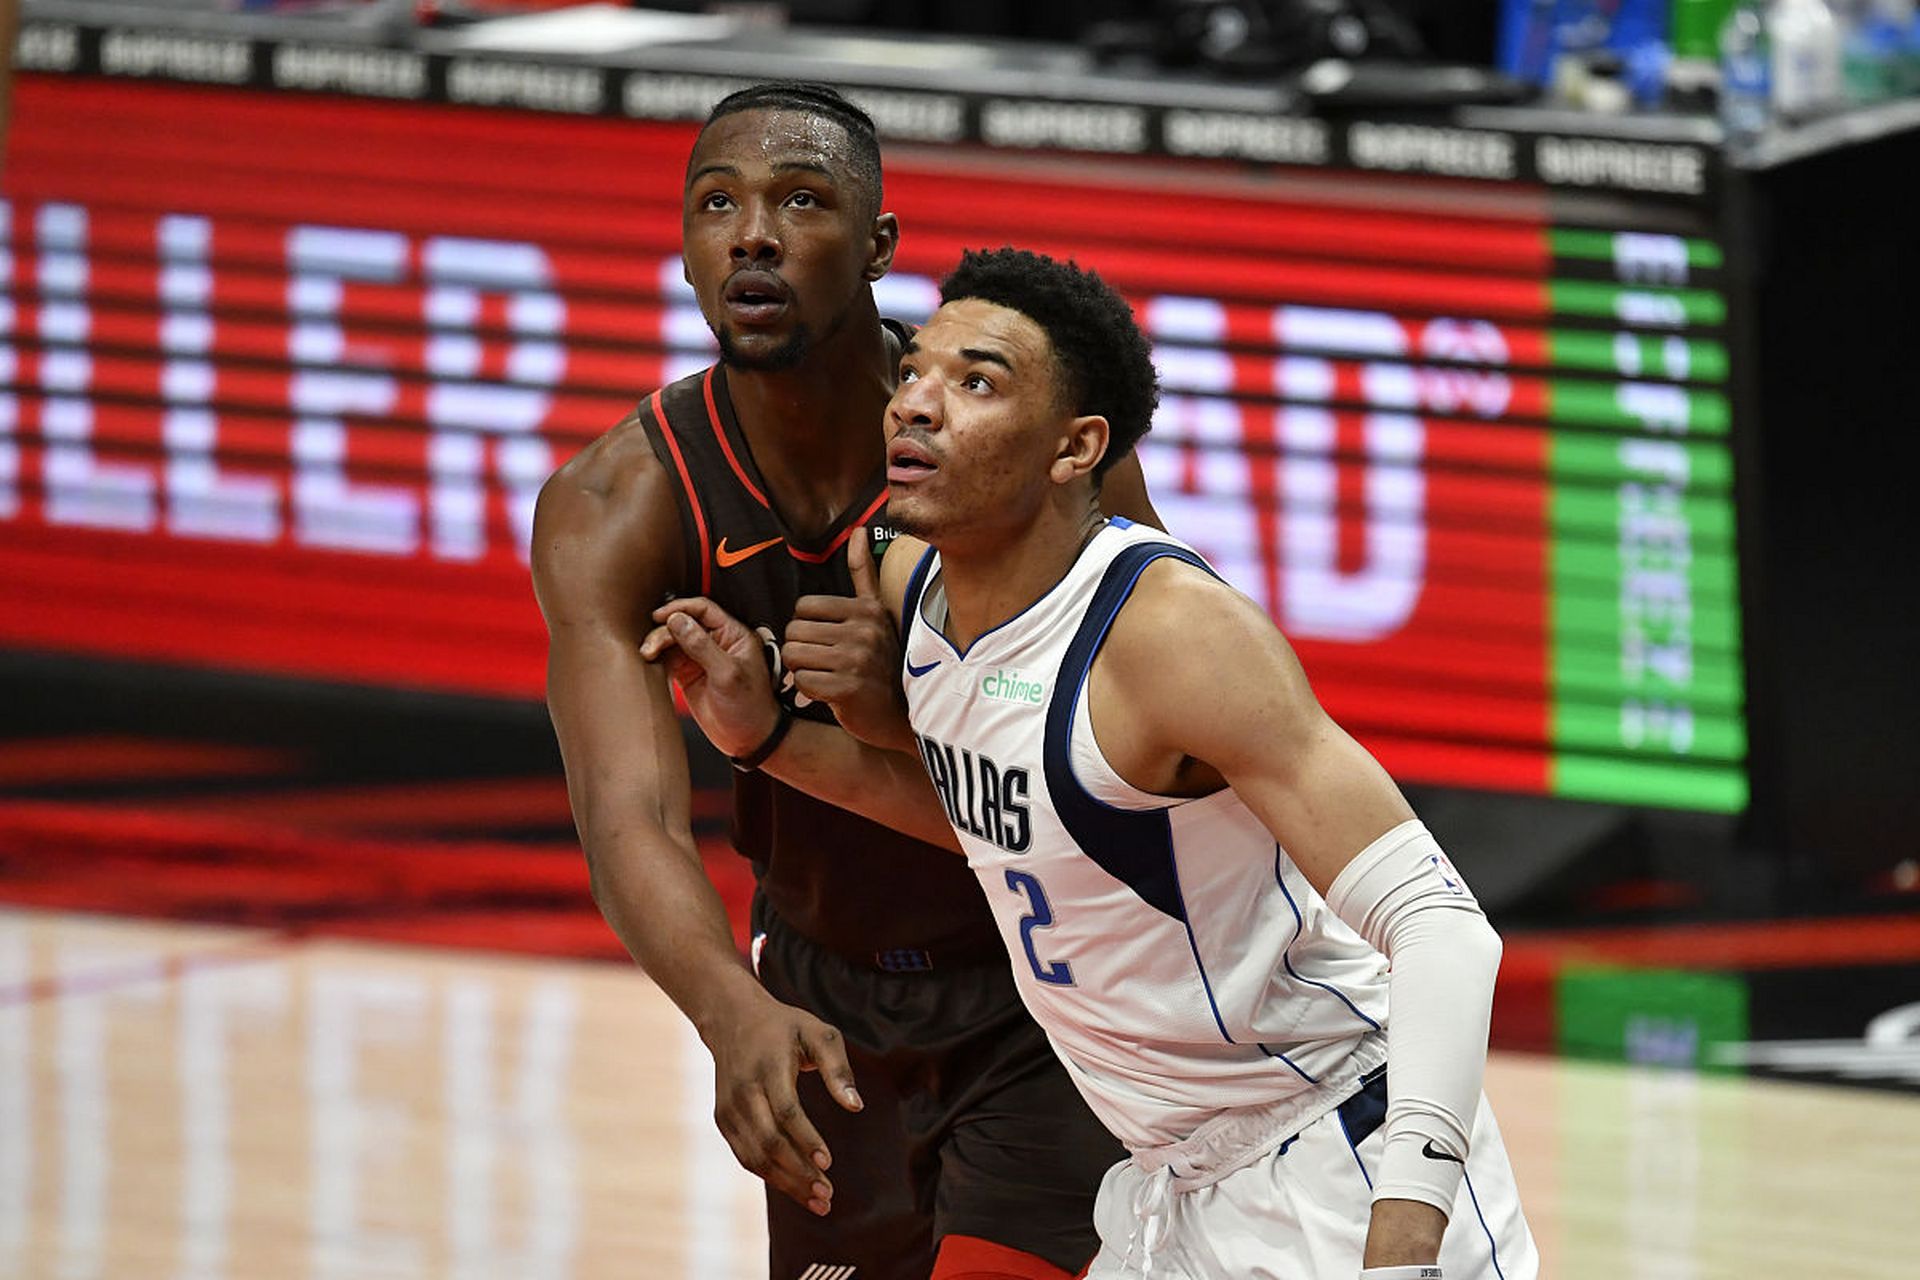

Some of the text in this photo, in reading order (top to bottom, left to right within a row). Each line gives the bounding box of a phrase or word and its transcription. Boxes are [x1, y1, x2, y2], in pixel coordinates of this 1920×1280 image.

[982, 670, 1043, 703] chime
[915, 733, 1033, 854] ALLAS
[1004, 869, 1077, 987] 2
